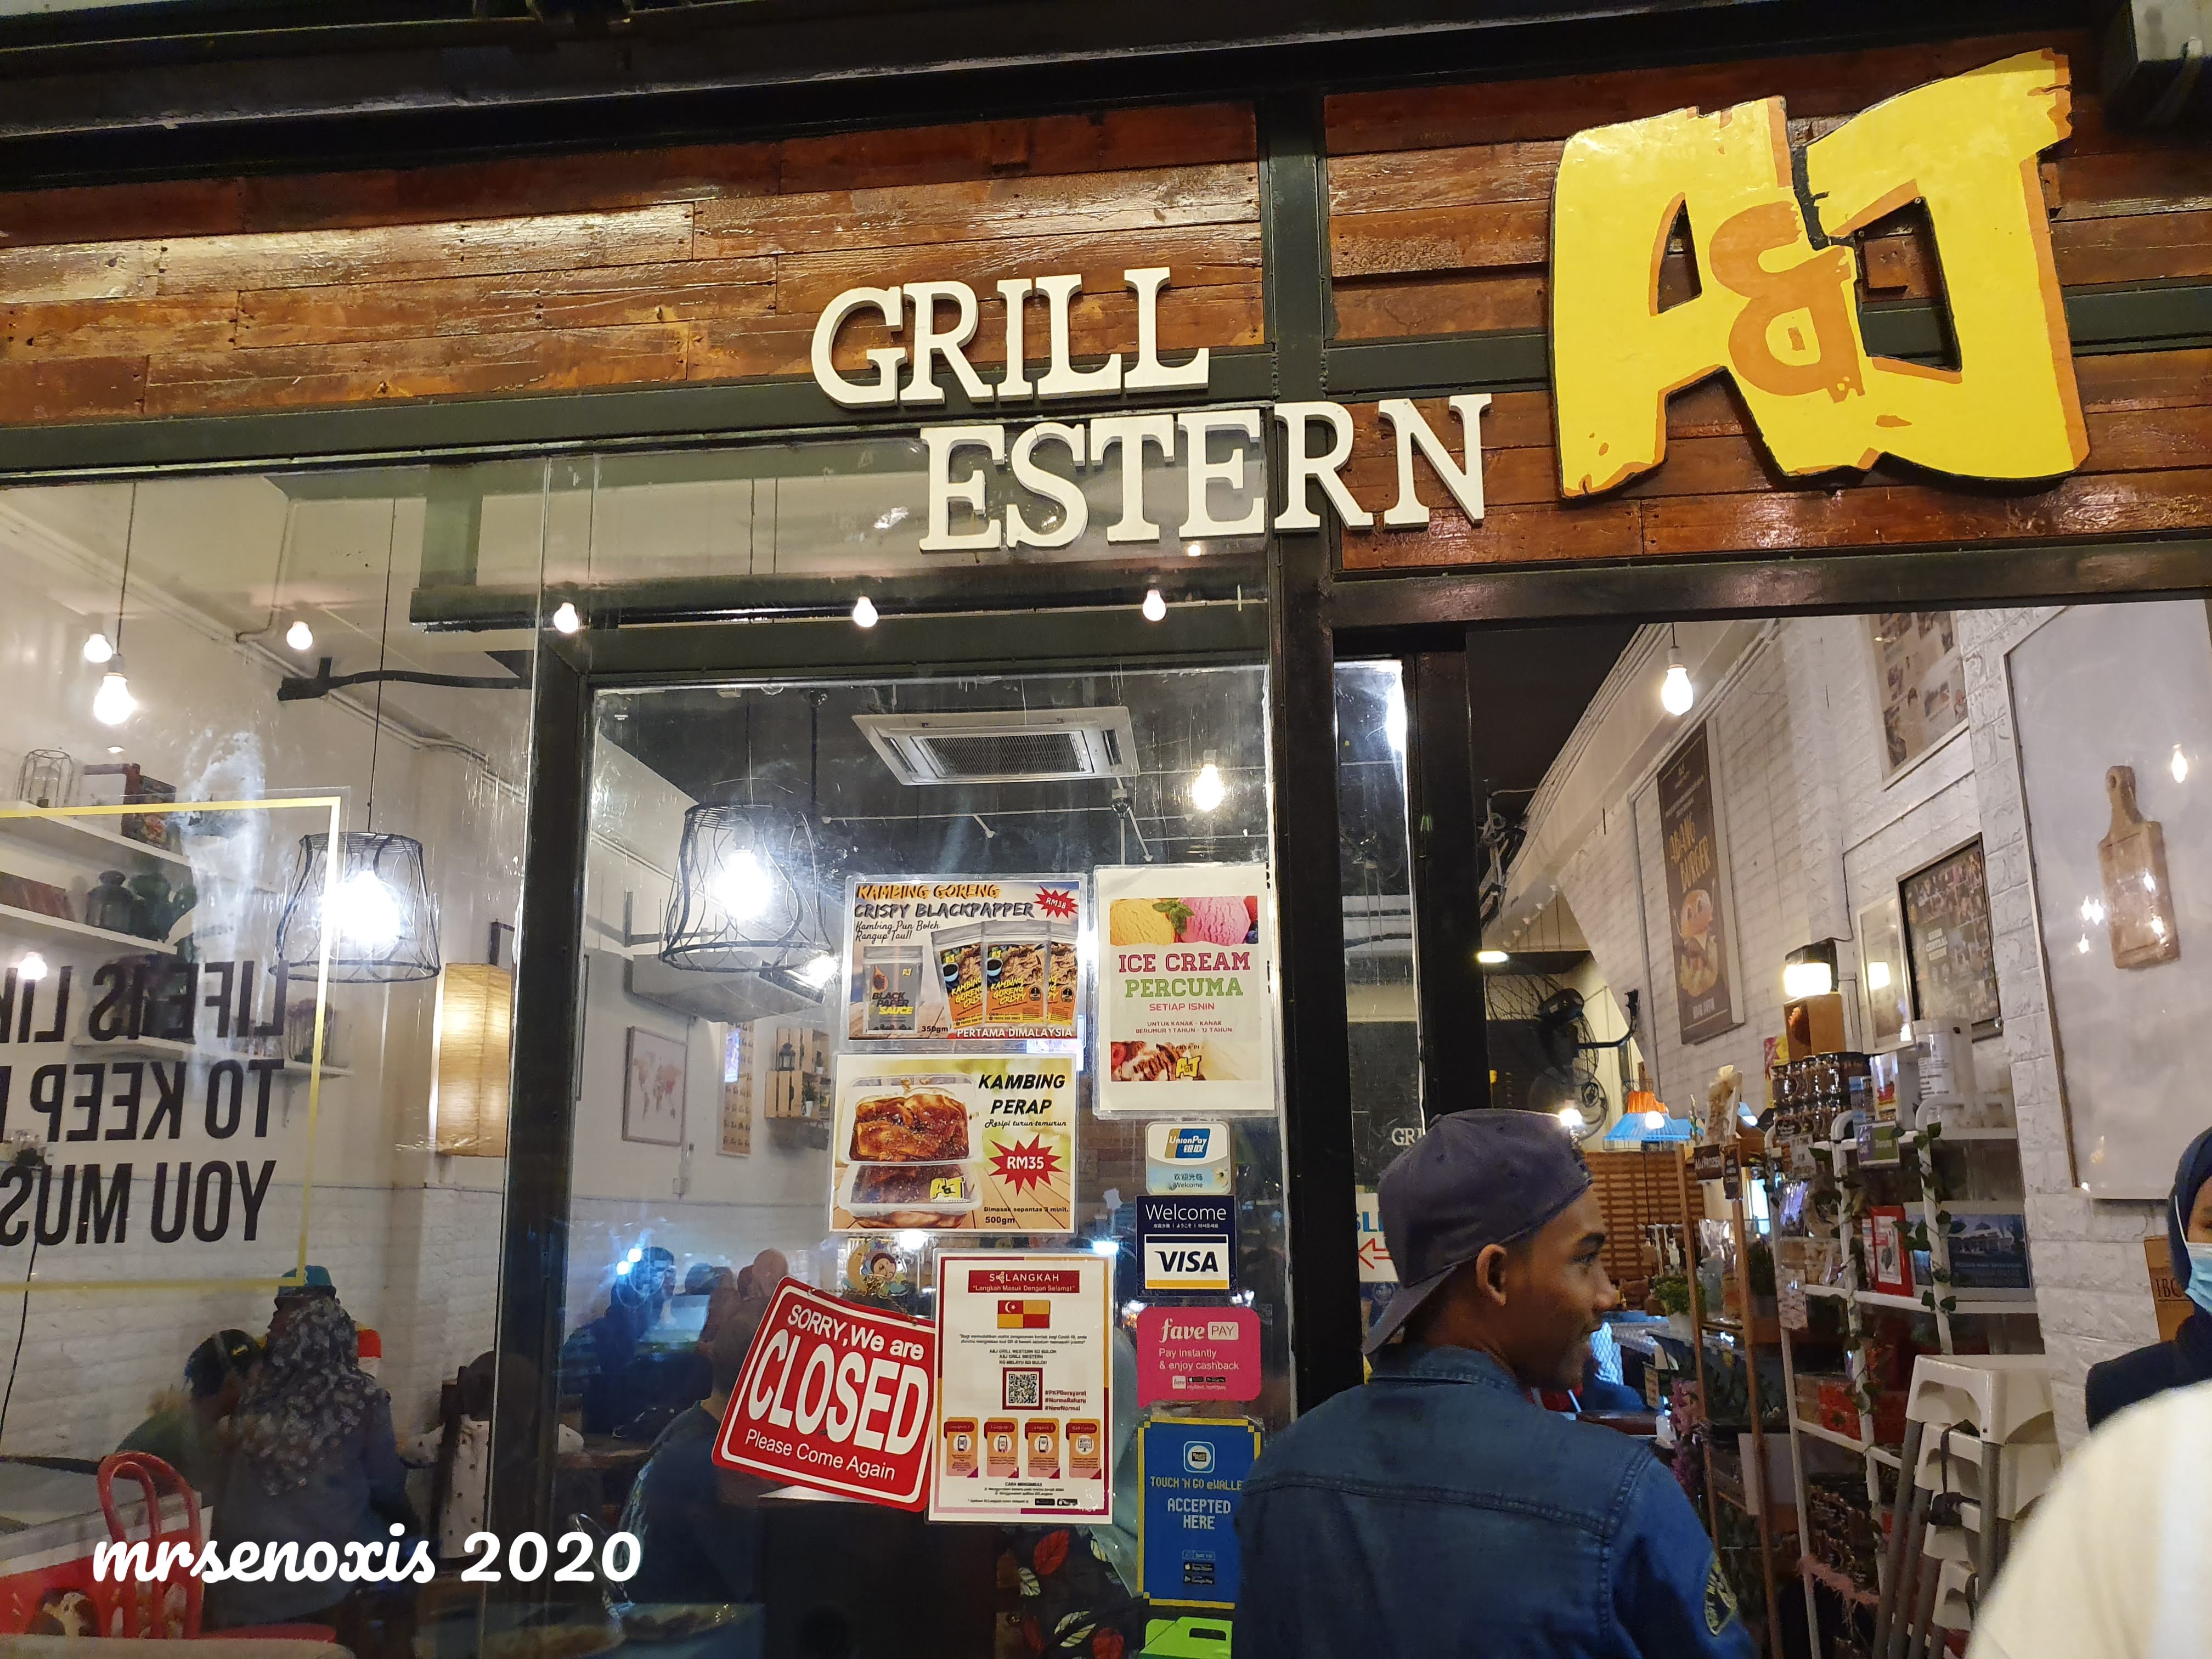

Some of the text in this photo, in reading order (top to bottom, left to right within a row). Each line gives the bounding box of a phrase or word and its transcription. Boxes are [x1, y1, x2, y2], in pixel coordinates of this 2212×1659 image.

[810, 267, 1209, 409] GRILL
[919, 392, 1492, 551] ESTERN
[857, 884, 1001, 900] KAMBING GORENG
[855, 902, 1035, 919] CRISPY BLACKPAPPER
[1046, 897, 1067, 910] RM38
[856, 920, 940, 934] Kambing Pun Boleh
[856, 930, 888, 944] Rangup
[1119, 952, 1250, 973] ICE CREAM
[991, 975, 1024, 991] KAMBING
[1125, 978, 1243, 998] PERCUMA
[993, 986, 1024, 999] GORENG
[999, 992, 1026, 1006] CRISPY
[1188, 1002, 1215, 1011] ISNIN
[957, 1027, 1073, 1037] PERTAMA DIMALAYSIA
[978, 1074, 1065, 1090] KAMBING
[991, 1099, 1052, 1116] PERAP
[1169, 1135, 1207, 1147] UnionPay
[1007, 1155, 1045, 1170] RM35
[985, 1216, 1015, 1224] 500gm
[1146, 1204, 1226, 1221] Welcome
[1154, 1251, 1218, 1272] VISA
[1159, 1318, 1234, 1343] fave PAY
[849, 1323, 884, 1352] We
[889, 1339, 924, 1361] are
[1159, 1348, 1217, 1359] Pay instantly
[1159, 1361, 1239, 1372] & enjoy cashback
[748, 1329, 929, 1456] CLOSED
[746, 1429, 895, 1481] Please Come Again
[1150, 1476, 1179, 1488] TOUCH
[1193, 1478, 1204, 1489] GO
[1207, 1479, 1243, 1491] eWALLE
[1167, 1497, 1231, 1514] ACCEPTED
[1183, 1515, 1215, 1530] HERE
